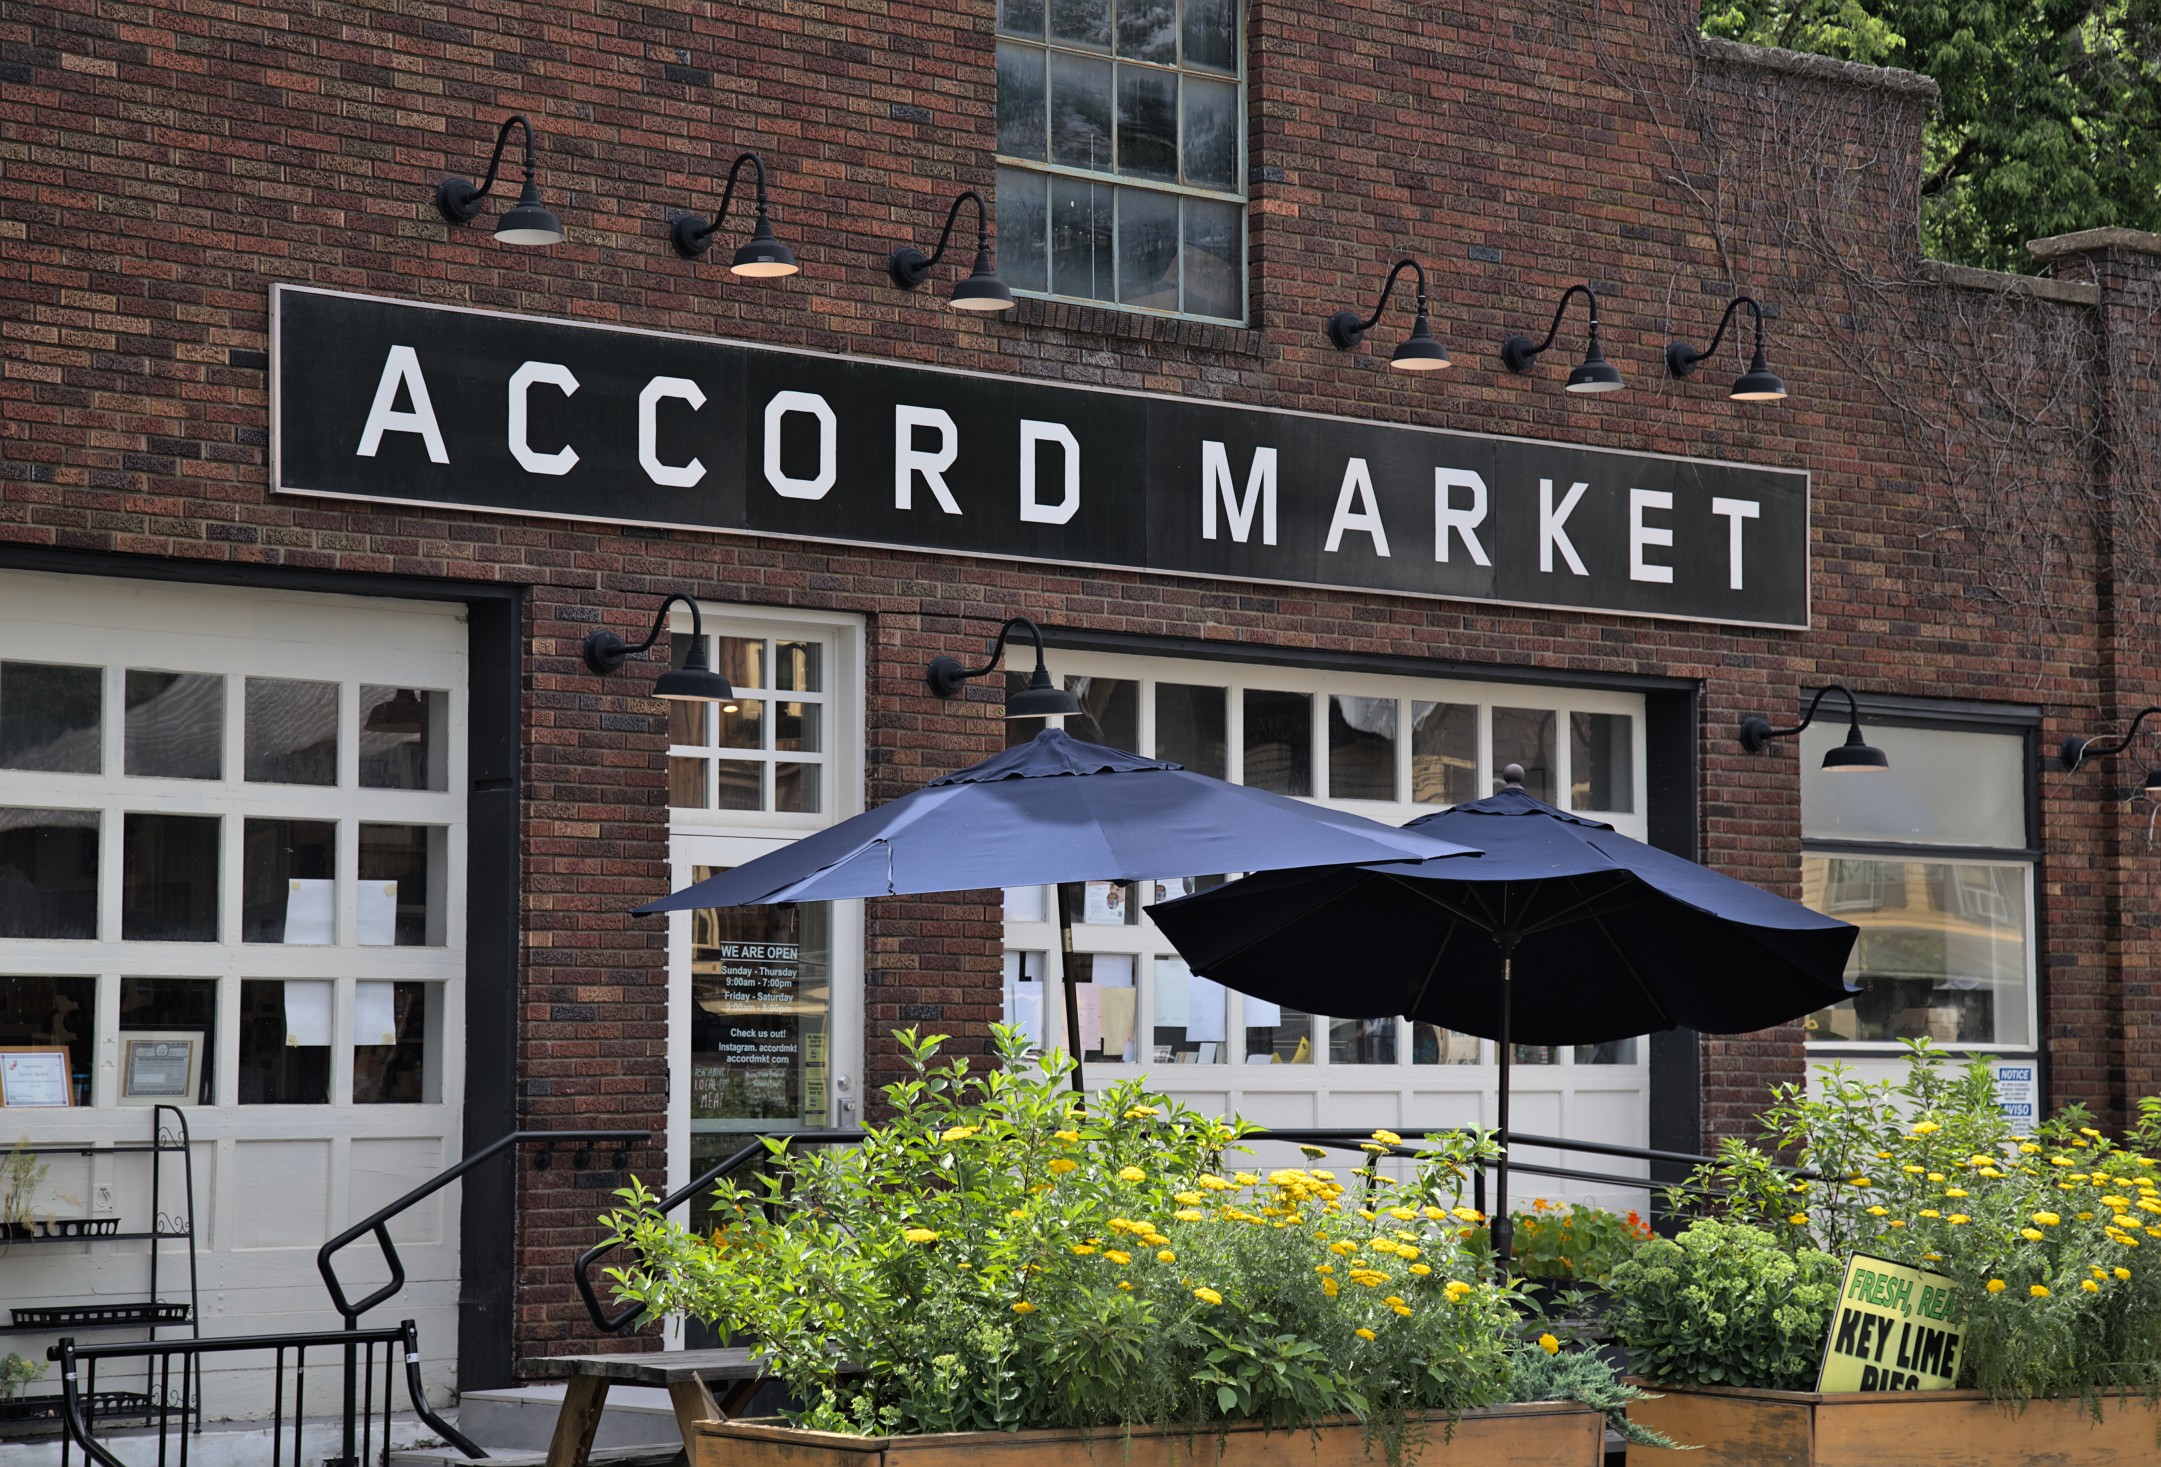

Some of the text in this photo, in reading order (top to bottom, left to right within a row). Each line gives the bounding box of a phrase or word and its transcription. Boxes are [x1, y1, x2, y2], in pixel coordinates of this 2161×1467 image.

[356, 344, 1761, 591] ACCORD MARKET
[721, 945, 798, 960] WE ARE OPEN
[721, 965, 753, 978] Sunday
[759, 966, 797, 979] Thursday
[726, 977, 756, 987] 9:00am
[762, 978, 792, 989] 7:00pm
[724, 991, 751, 1003] Friday
[757, 992, 794, 1004] Saturday
[725, 1003, 755, 1012] 9:00am
[762, 1004, 792, 1014] 8:00pm
[730, 1028, 787, 1039] Check us out!
[758, 1044, 798, 1053] accordmkt
[2001, 1069, 2030, 1080] NOTICE
[694, 1079, 717, 1091] LOCAL
[700, 1091, 724, 1109] MEAT
[2004, 1104, 2030, 1115] AVISO
[1848, 1268, 1959, 1325] FRESH, REA
[1834, 1308, 1960, 1380] KEY LIME
